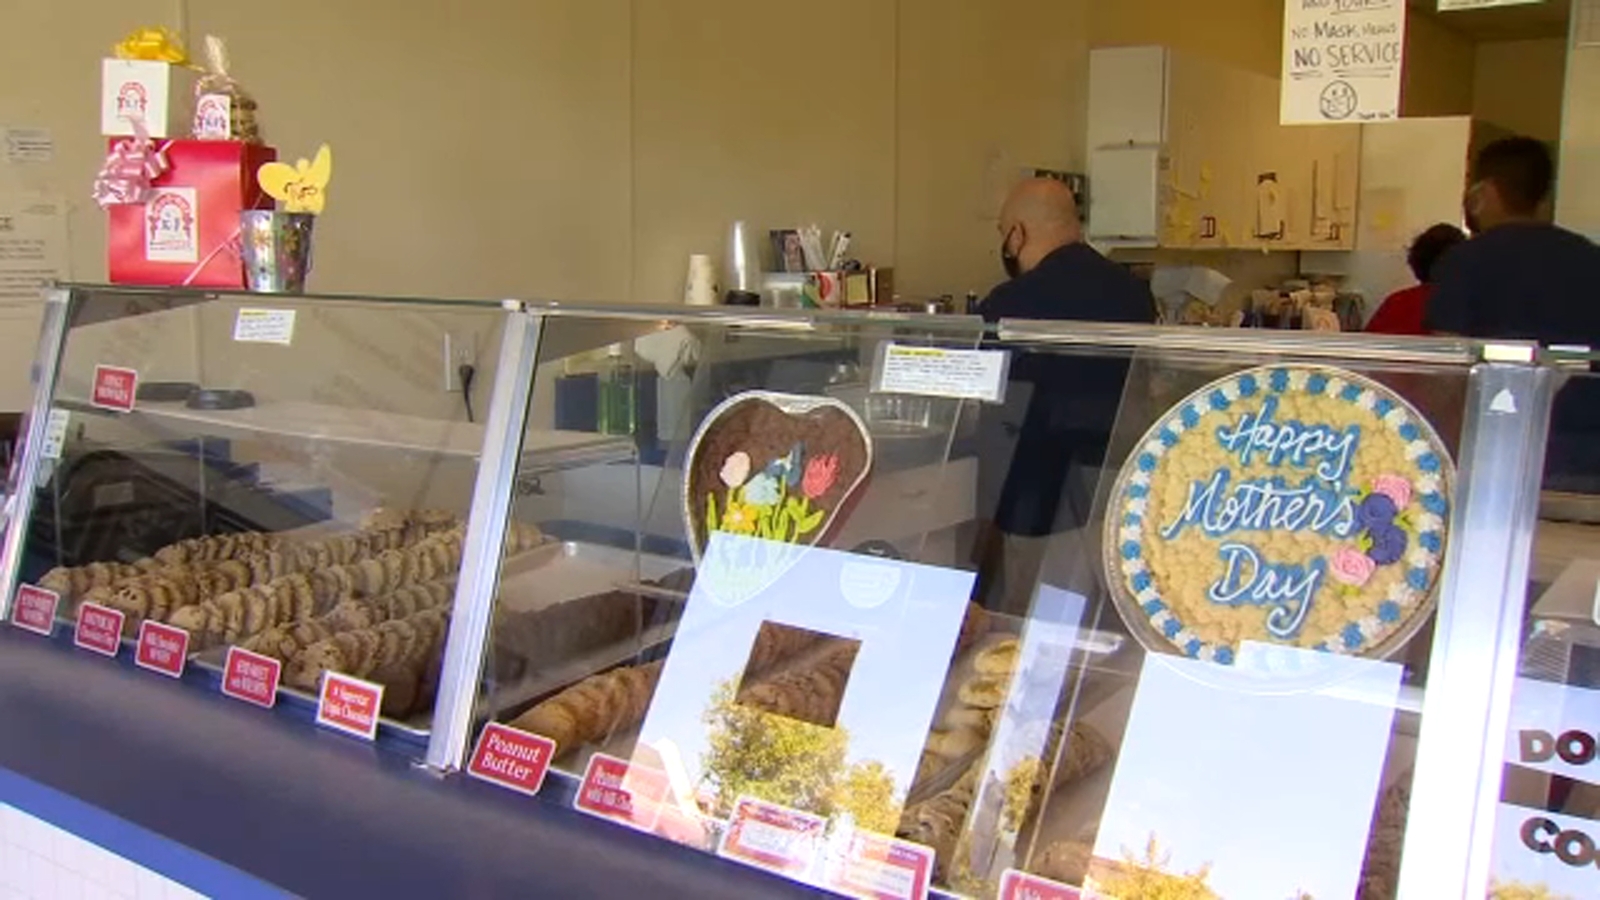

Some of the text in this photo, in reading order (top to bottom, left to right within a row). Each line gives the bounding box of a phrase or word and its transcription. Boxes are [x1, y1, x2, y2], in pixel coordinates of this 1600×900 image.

[1294, 42, 1401, 68] NO SERVICE
[1217, 395, 1361, 482] Happy
[1160, 472, 1356, 536] Mother's
[1208, 543, 1321, 637] Day
[480, 753, 533, 782] Butter
[486, 732, 543, 764] Peanut
[1519, 728, 1600, 766] DO
[1520, 816, 1600, 868] CO
